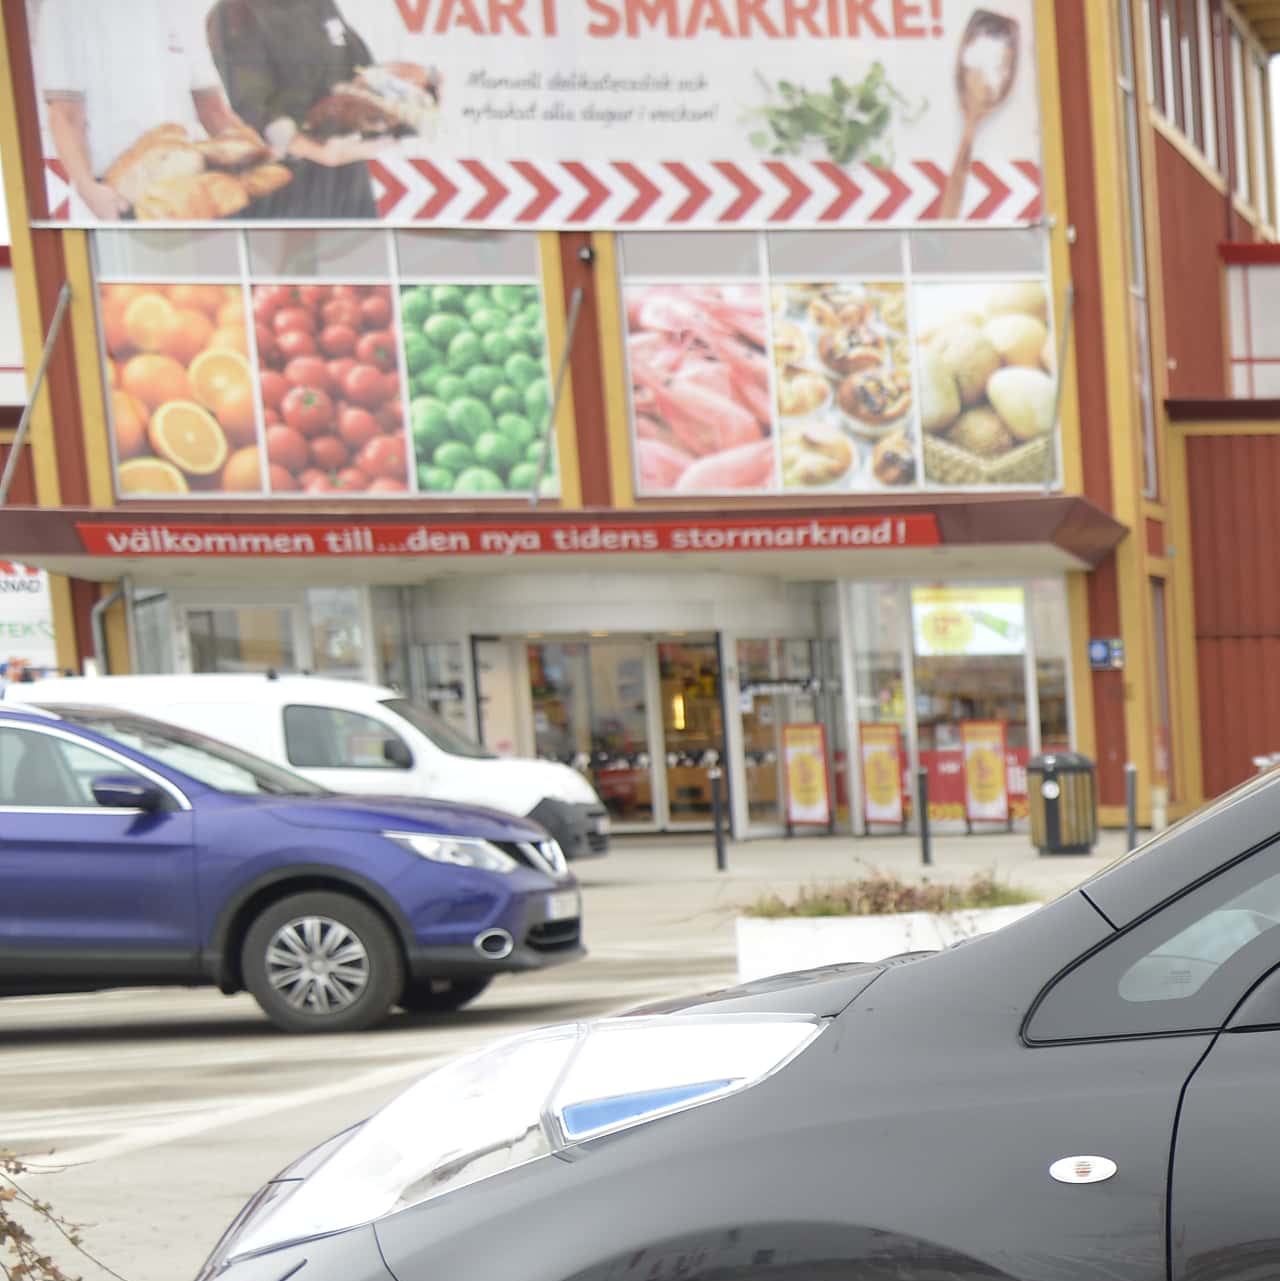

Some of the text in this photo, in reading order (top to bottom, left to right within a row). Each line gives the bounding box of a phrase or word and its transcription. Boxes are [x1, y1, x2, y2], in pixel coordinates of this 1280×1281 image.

[586, 0, 945, 39] SMAKRIKE!
[106, 527, 316, 554] välkommen
[480, 530, 540, 556] nya
[553, 522, 659, 550] tidens
